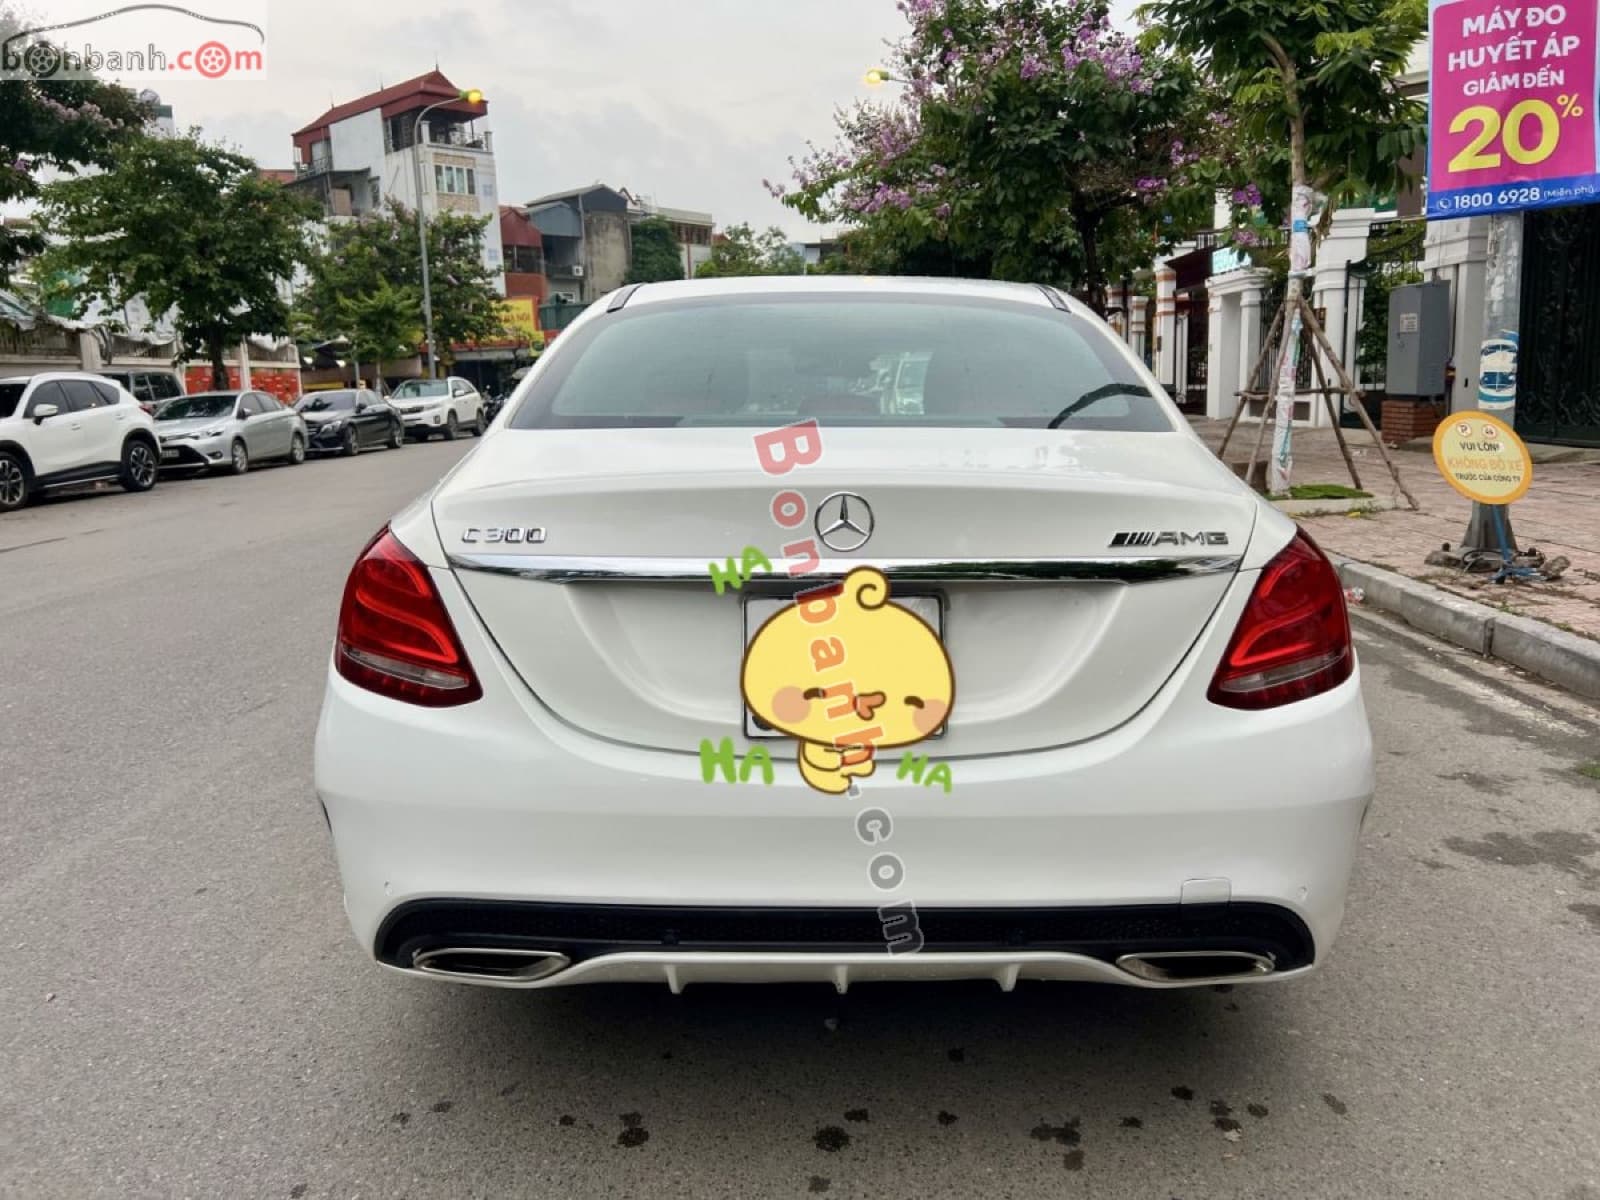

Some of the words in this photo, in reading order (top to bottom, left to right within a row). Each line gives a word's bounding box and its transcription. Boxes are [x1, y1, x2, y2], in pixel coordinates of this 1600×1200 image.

[1462, 6, 1521, 37] MÁY
[1525, 4, 1567, 28] ĐO
[1447, 31, 1537, 72] HUYẾT
[1542, 32, 1581, 58] ÁP
[1462, 71, 1520, 96] GIẢM
[1523, 64, 1565, 89] ĐẾN
[1448, 93, 1583, 172] 20%
[1454, 191, 1493, 209] 1800
[1497, 187, 1540, 205] 6928
[1459, 441, 1476, 451] VUI
[1448, 456, 1487, 470] KHÔNG
[1151, 531, 1229, 547] AMG
